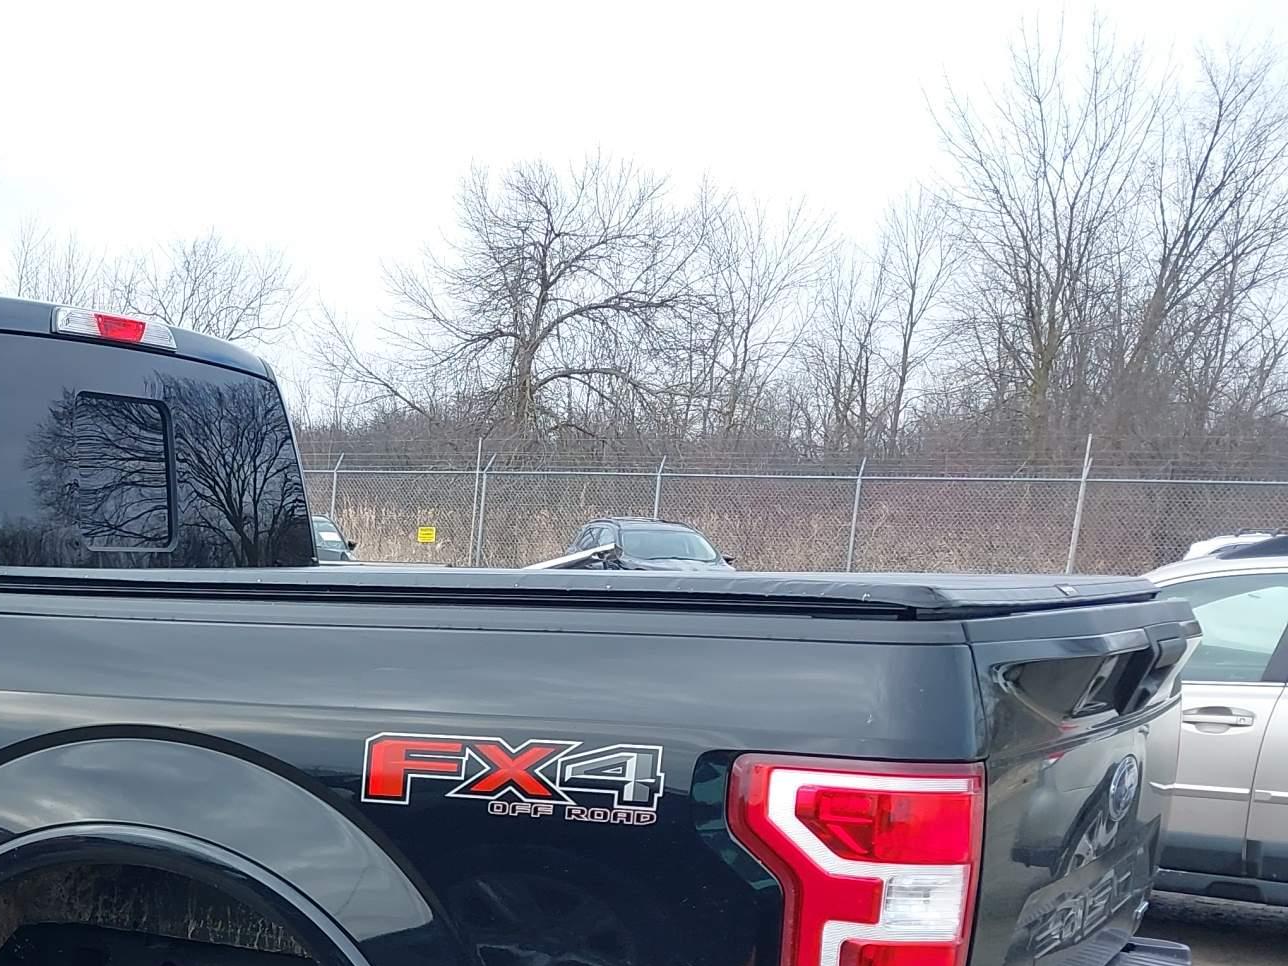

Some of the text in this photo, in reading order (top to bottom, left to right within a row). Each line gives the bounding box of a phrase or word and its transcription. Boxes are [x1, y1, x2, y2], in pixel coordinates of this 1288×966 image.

[361, 732, 665, 812] FX4
[488, 801, 657, 825] OFF ROAD
